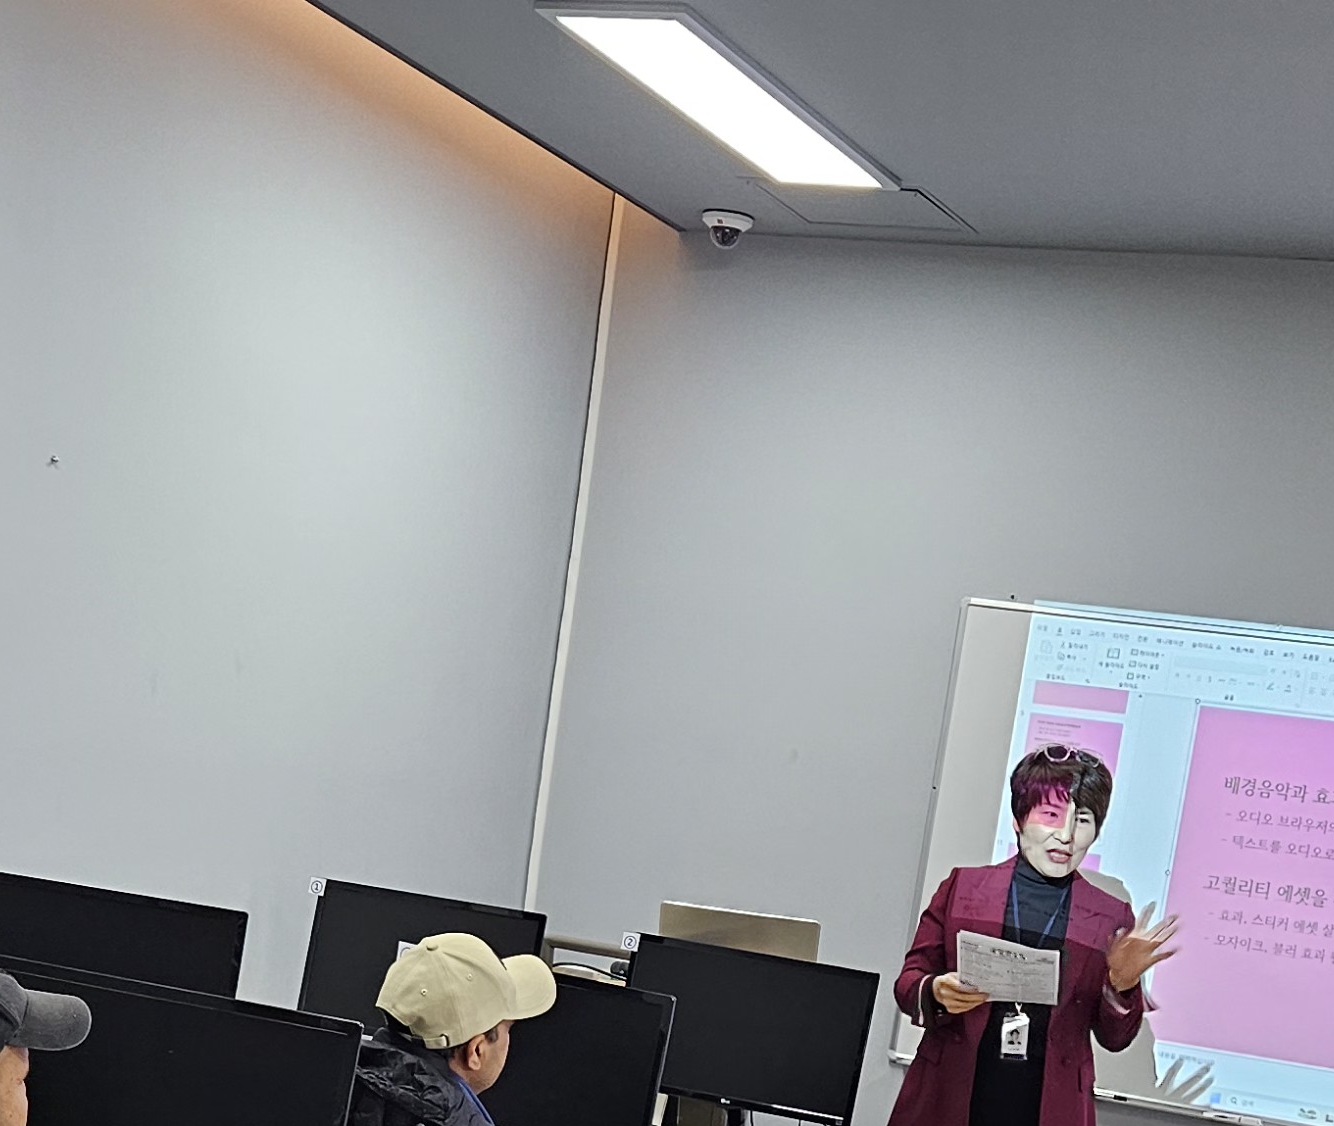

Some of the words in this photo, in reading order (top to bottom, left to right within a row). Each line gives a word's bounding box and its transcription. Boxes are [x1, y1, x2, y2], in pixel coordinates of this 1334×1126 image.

[1224, 776, 1308, 803] 배경음악과
[1236, 809, 1273, 826] 오디오
[1232, 835, 1282, 854] 텍스트를
[1202, 875, 1271, 900] 고퀄리티
[1277, 884, 1328, 908] 에셋을
[1251, 914, 1289, 931] 스티커
[1293, 919, 1319, 936] 에셋
[1272, 942, 1297, 958] 블러
[1301, 947, 1326, 963] 효과
